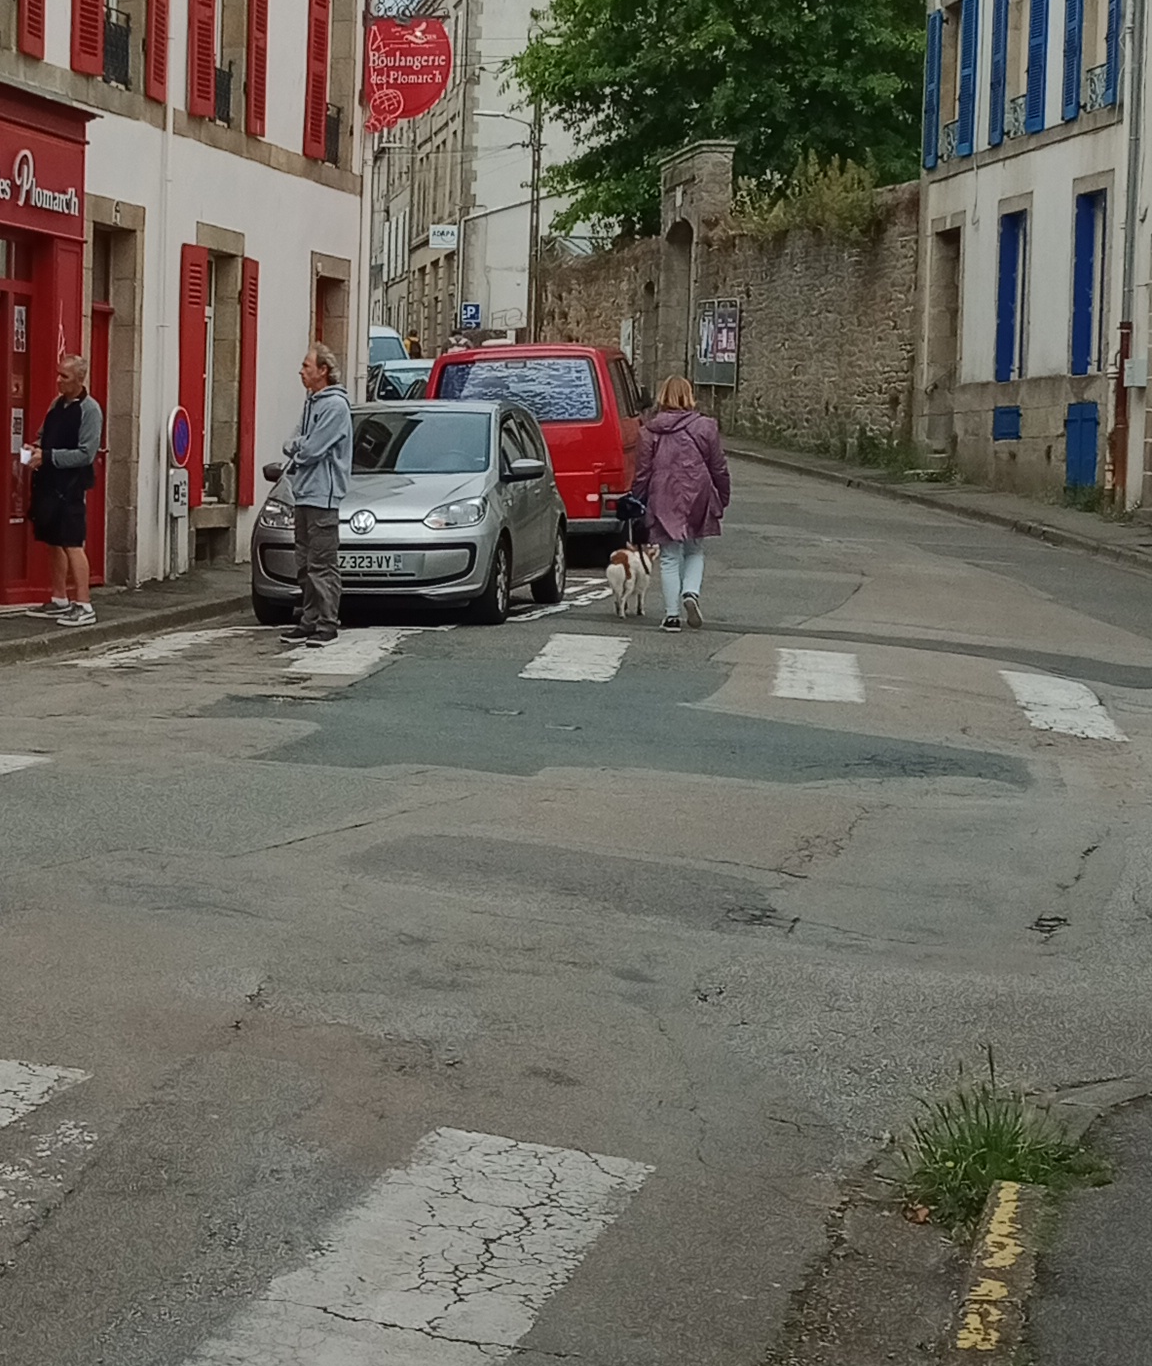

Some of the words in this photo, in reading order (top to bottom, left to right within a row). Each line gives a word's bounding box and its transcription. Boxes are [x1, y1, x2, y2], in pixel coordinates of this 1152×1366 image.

[369, 51, 446, 71] Boulangerie
[370, 71, 386, 84] des
[388, 70, 442, 84] Plomarc'h
[14, 149, 80, 216] Plomarc'h
[467, 306, 475, 316] P
[338, 556, 391, 569] Z-323-VY
